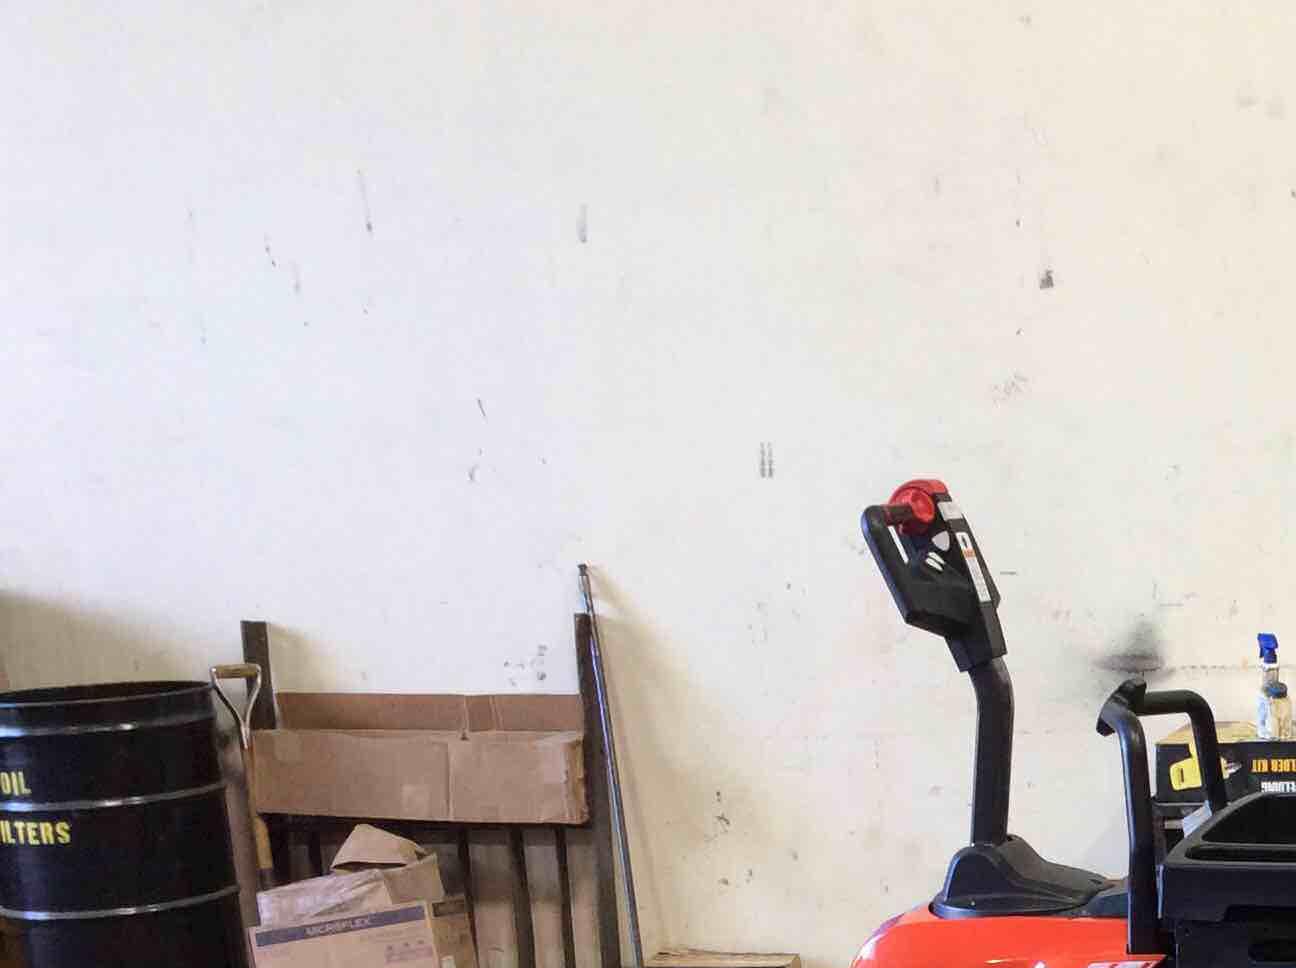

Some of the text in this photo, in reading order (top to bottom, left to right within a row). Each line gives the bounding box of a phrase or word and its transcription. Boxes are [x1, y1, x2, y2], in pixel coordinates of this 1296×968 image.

[1251, 759, 1269, 773] KIT
[0, 771, 32, 796] OIL
[0, 820, 71, 846] ILTERS
